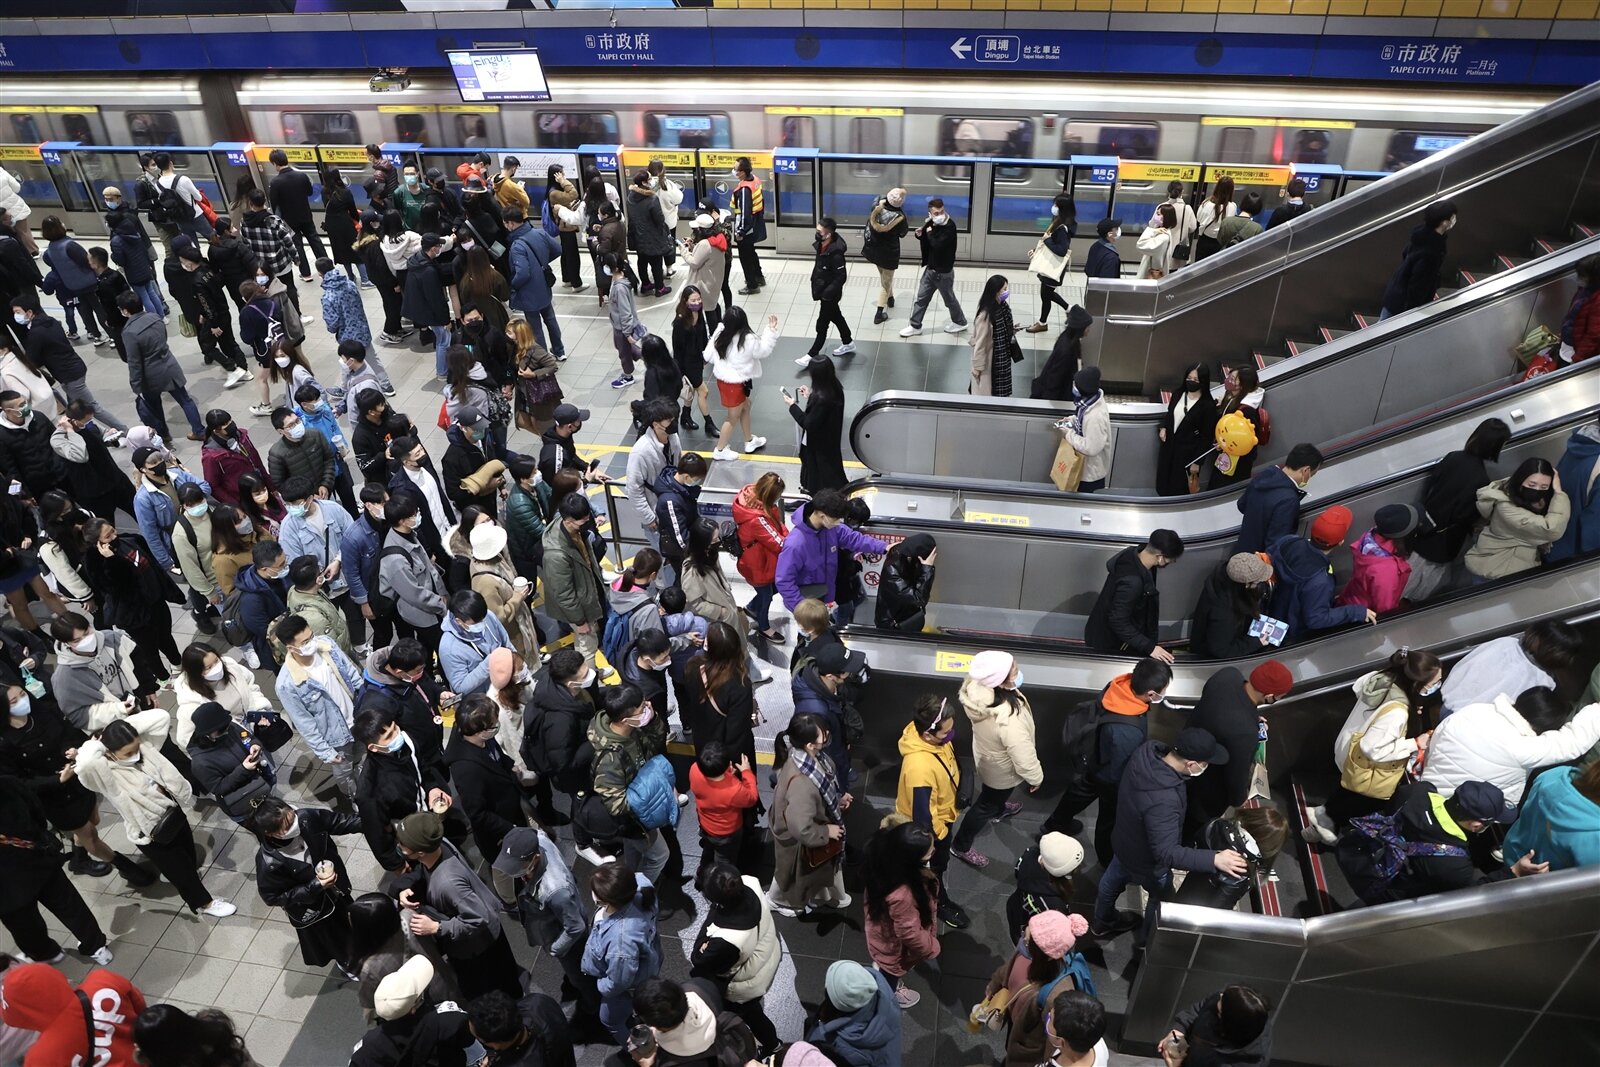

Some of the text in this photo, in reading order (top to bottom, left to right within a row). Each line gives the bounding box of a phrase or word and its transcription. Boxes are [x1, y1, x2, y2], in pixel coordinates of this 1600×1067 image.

[597, 32, 650, 50] 市政府
[985, 39, 1009, 51] 頂埔
[1023, 45, 1061, 54] 台北車站
[1398, 43, 1462, 64] 市政府
[984, 52, 1009, 60] Dingpu
[1468, 60, 1498, 70] 二月台
[1390, 66, 1458, 75] TAIPEI CITY HALL
[53, 152, 61, 162] 4
[239, 153, 246, 163] 4
[394, 154, 401, 164] 4
[609, 156, 617, 167] 4
[788, 160, 796, 171] 4
[1106, 169, 1115, 180] 5
[1309, 177, 1318, 188] 5
